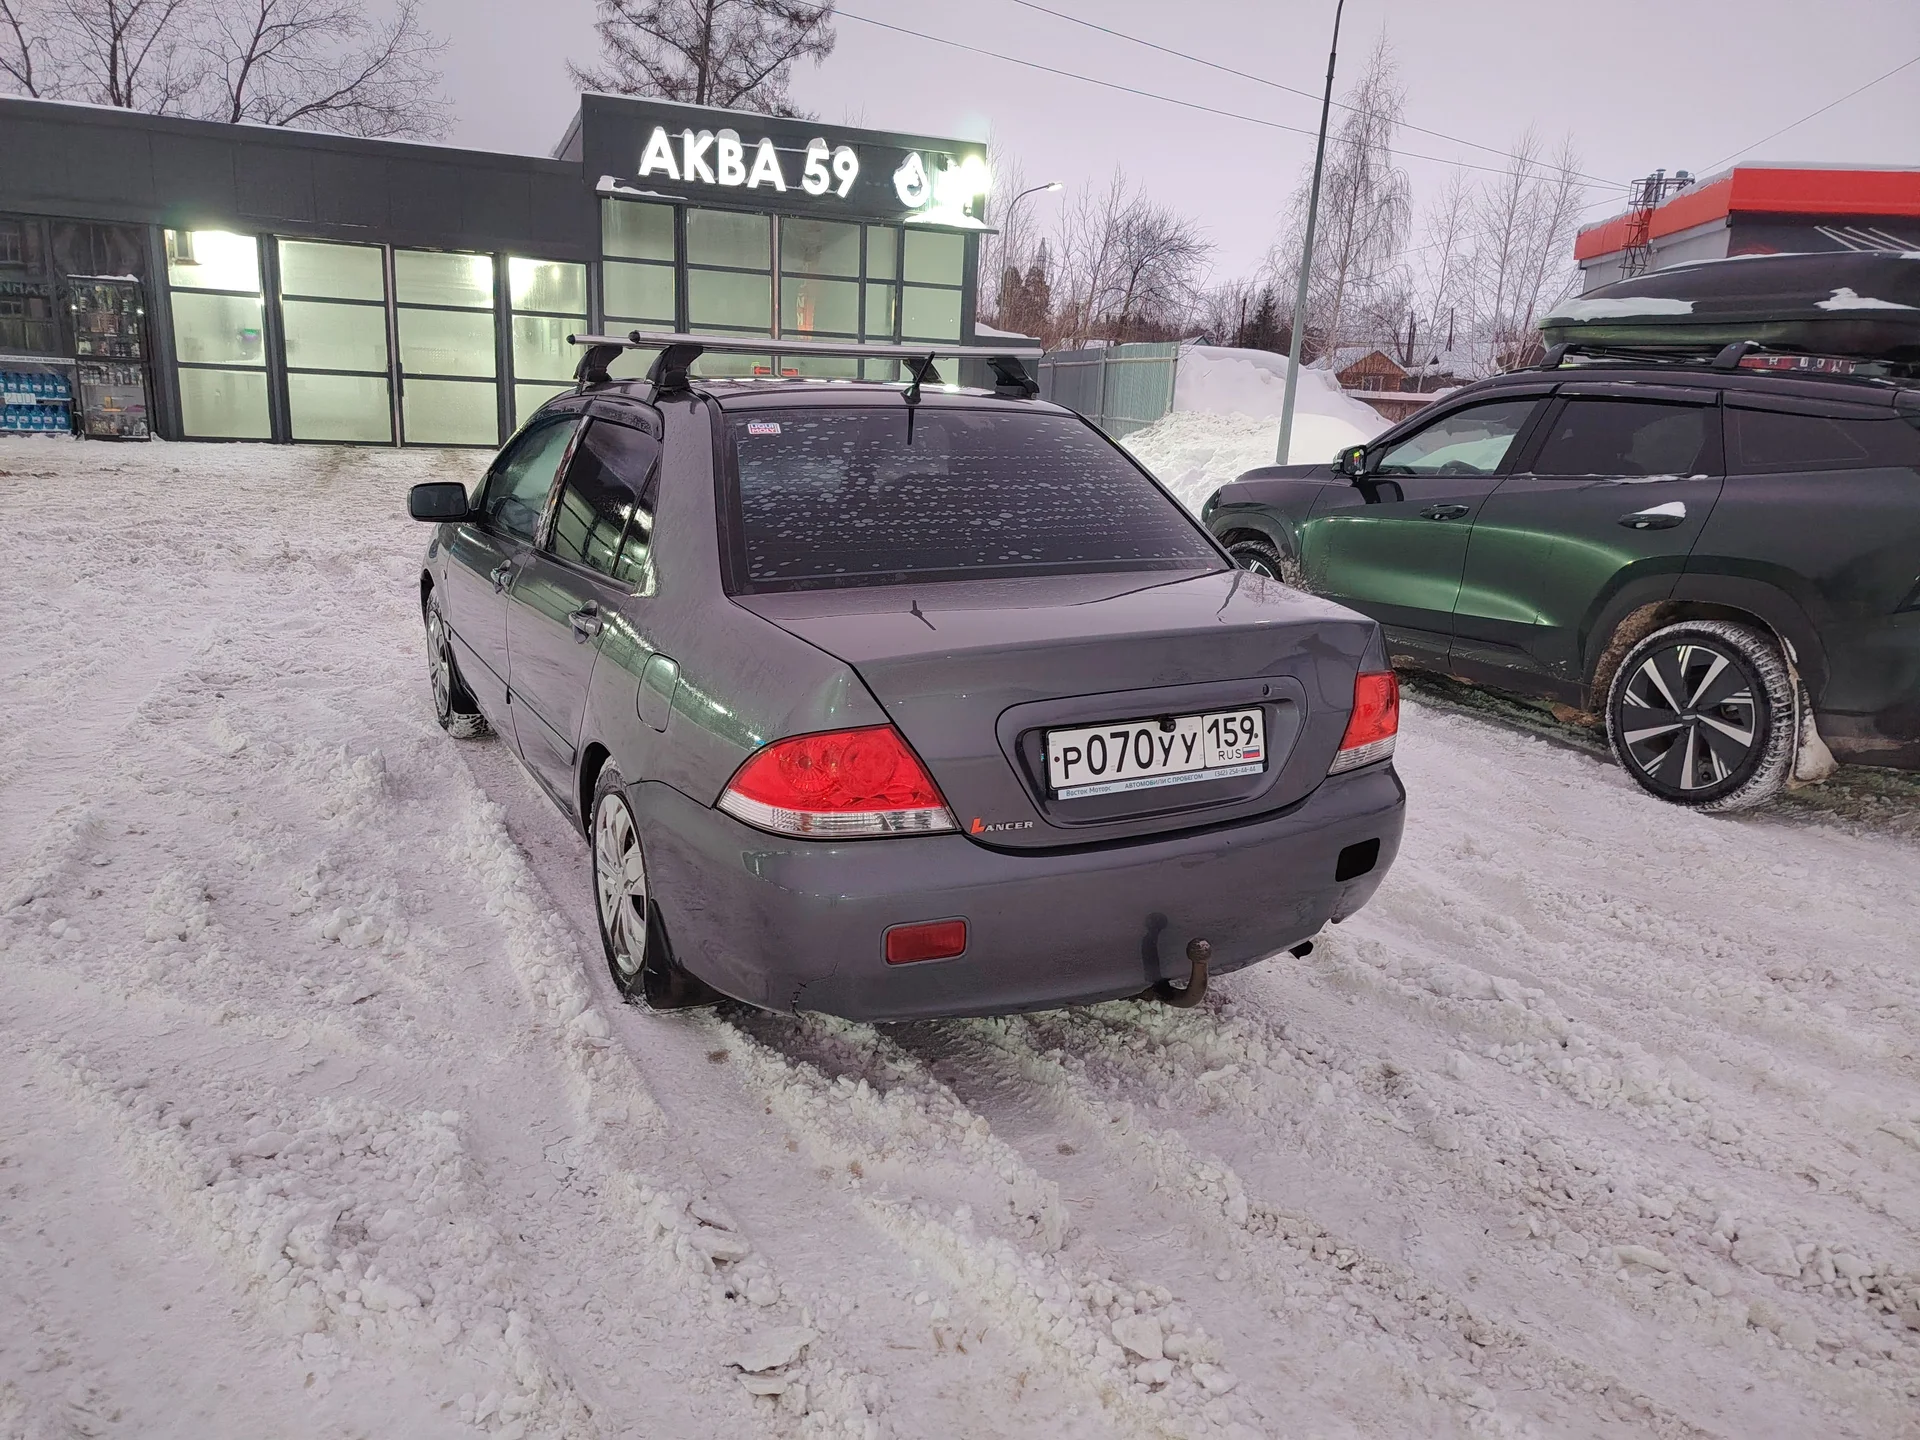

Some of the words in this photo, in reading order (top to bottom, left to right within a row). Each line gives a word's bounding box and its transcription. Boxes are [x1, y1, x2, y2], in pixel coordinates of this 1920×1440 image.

[637, 126, 787, 192] АКВА
[801, 141, 860, 199] 59
[1206, 715, 1256, 749] 159
[1218, 748, 1242, 761] RUS
[1066, 788, 1088, 798] Восток
[1088, 785, 1112, 796] Моторс
[1124, 778, 1167, 790] АВТОМОБИЛИ
[1172, 773, 1204, 783] ПРОБЕГОМ
[1214, 770, 1228, 778] (342)
[970, 818, 1034, 834] LANCER
